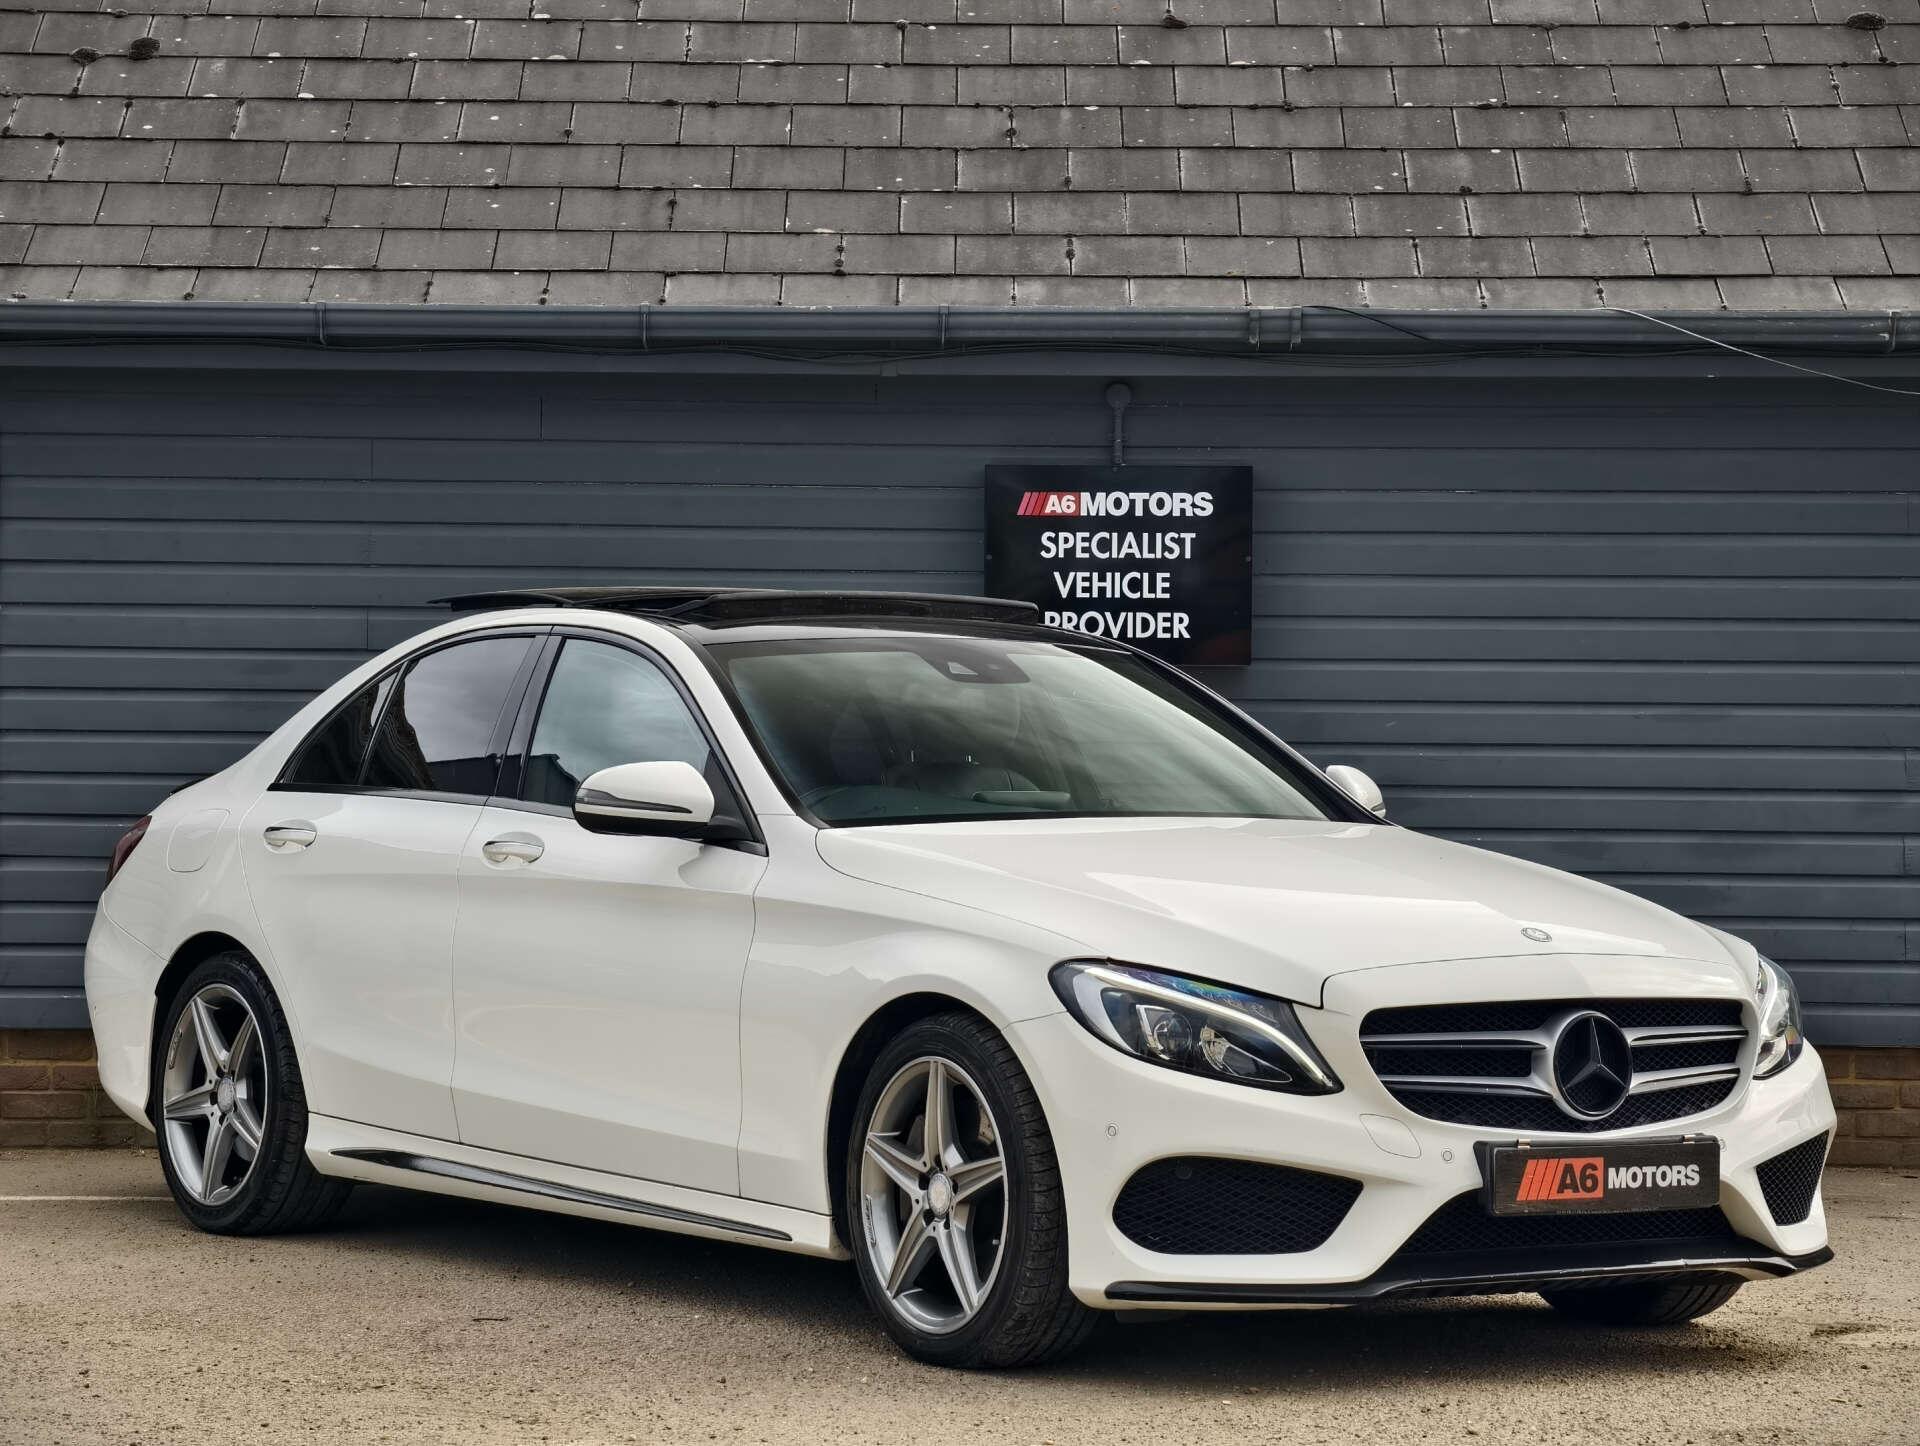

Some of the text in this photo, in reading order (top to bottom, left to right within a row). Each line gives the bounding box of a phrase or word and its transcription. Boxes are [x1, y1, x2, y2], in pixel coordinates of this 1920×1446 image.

[1045, 491, 1214, 517] A6 MOTORS
[1040, 531, 1196, 559] SPECIALIST
[1053, 571, 1171, 599] VEHICLE
[1044, 610, 1191, 639] PROVIDER
[1557, 1162, 1700, 1194] A6 MOTORS
